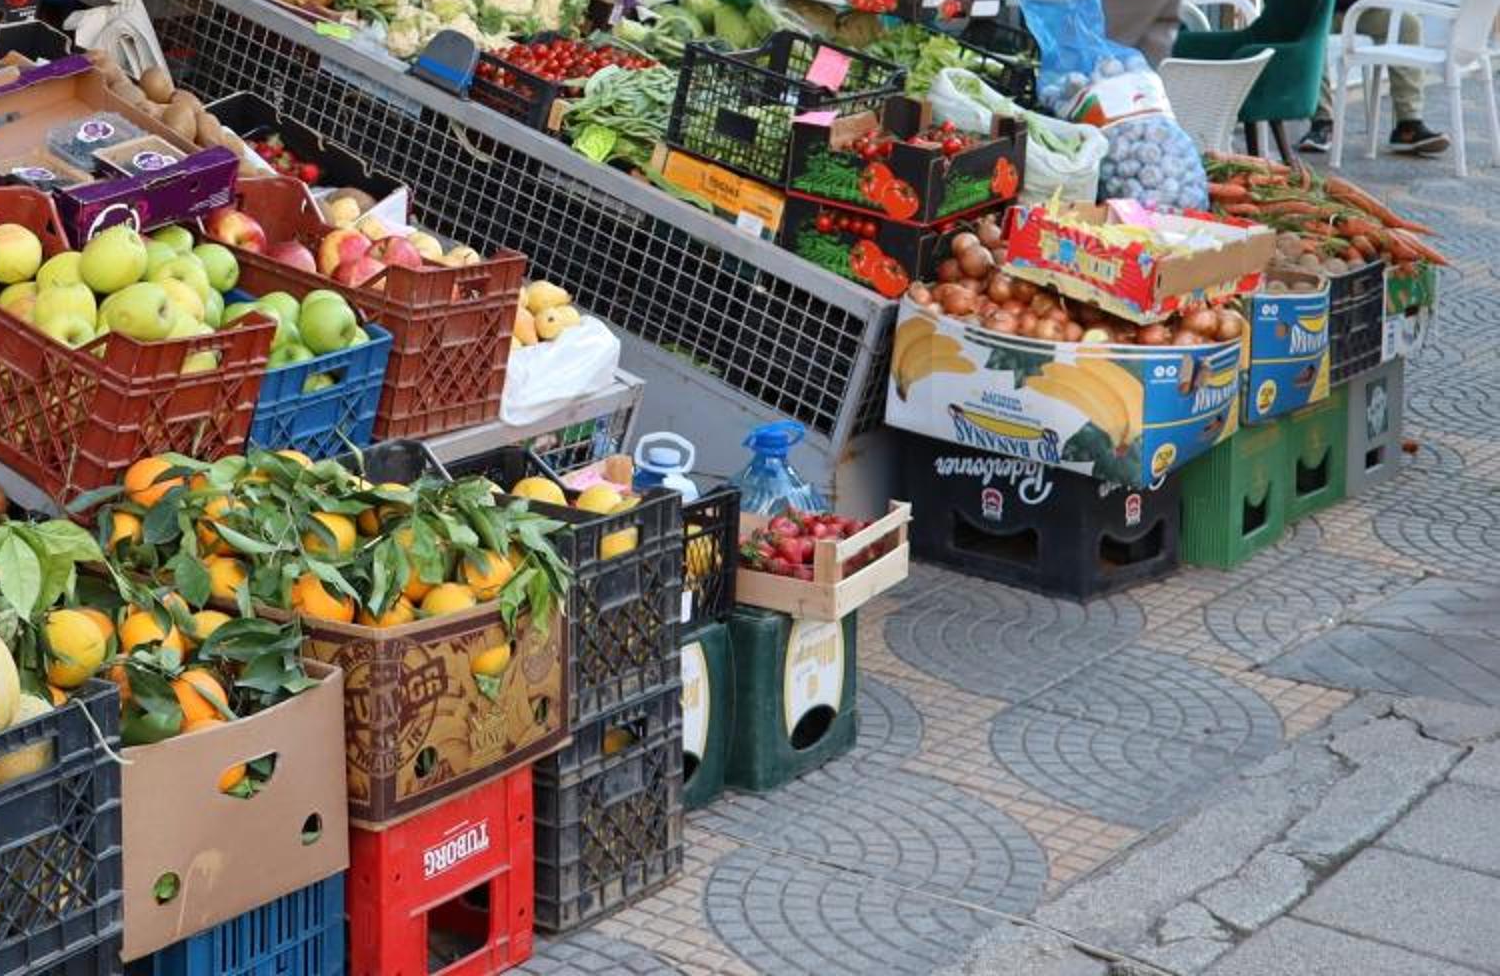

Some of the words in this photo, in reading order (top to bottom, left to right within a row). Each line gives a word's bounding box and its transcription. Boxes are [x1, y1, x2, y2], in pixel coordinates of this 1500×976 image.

[952, 414, 1031, 459] BANANAS
[933, 456, 1054, 506] Paderborner
[422, 822, 490, 877] TUBORG
